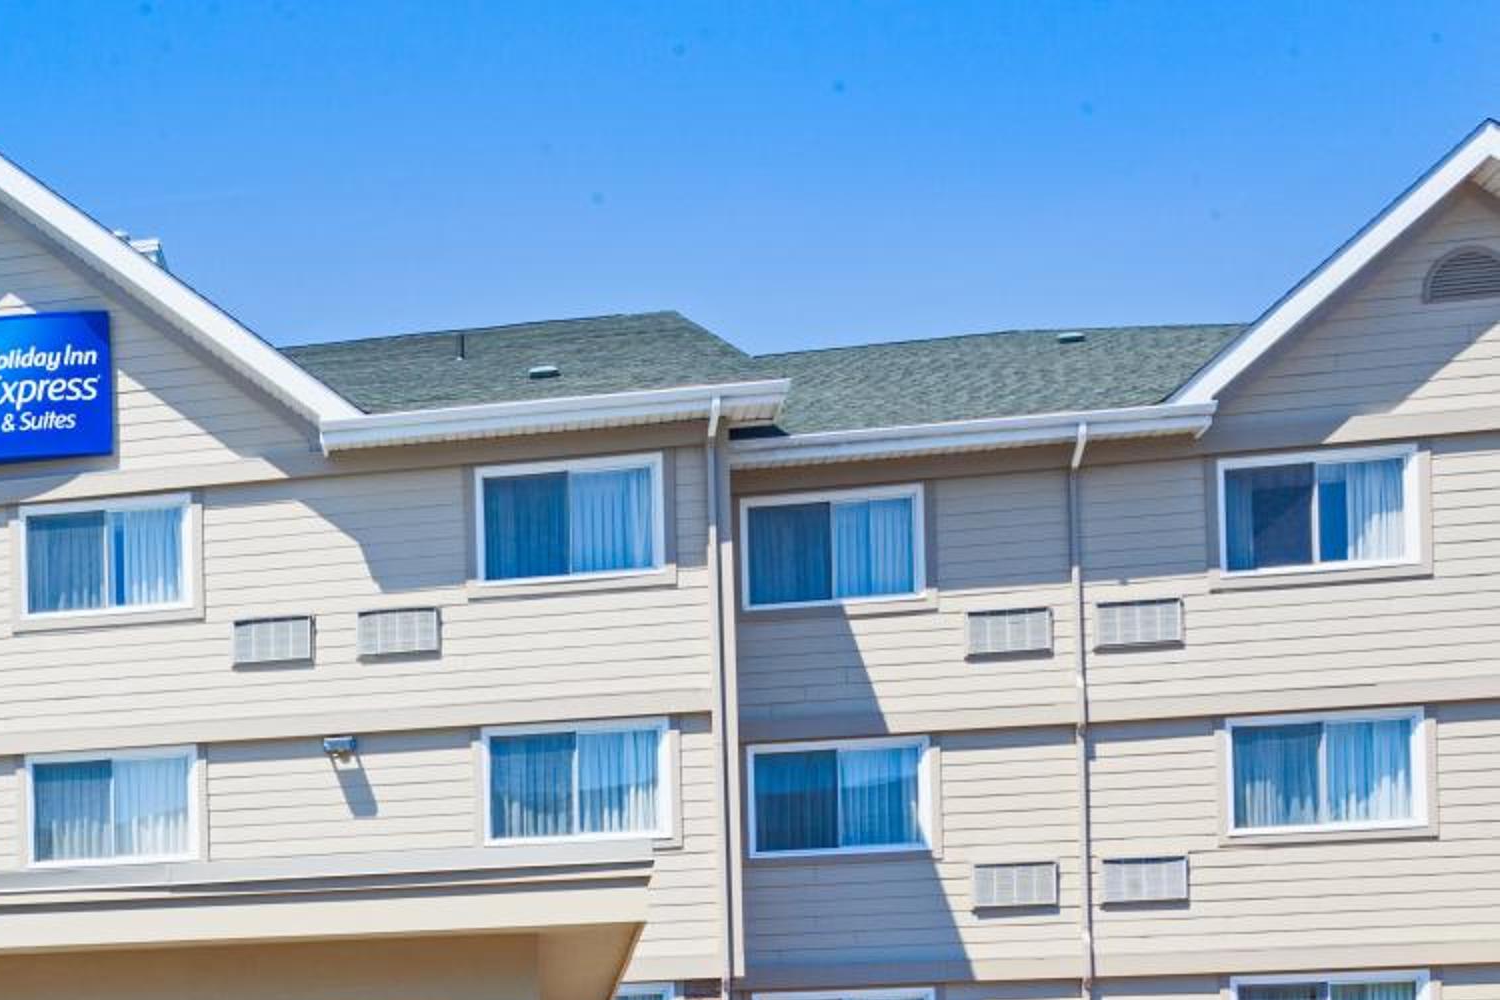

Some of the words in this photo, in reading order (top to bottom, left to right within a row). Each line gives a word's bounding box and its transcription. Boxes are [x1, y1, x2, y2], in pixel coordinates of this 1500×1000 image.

[64, 344, 98, 365] Inn
[1, 414, 15, 433] &
[19, 410, 77, 432] Suites
